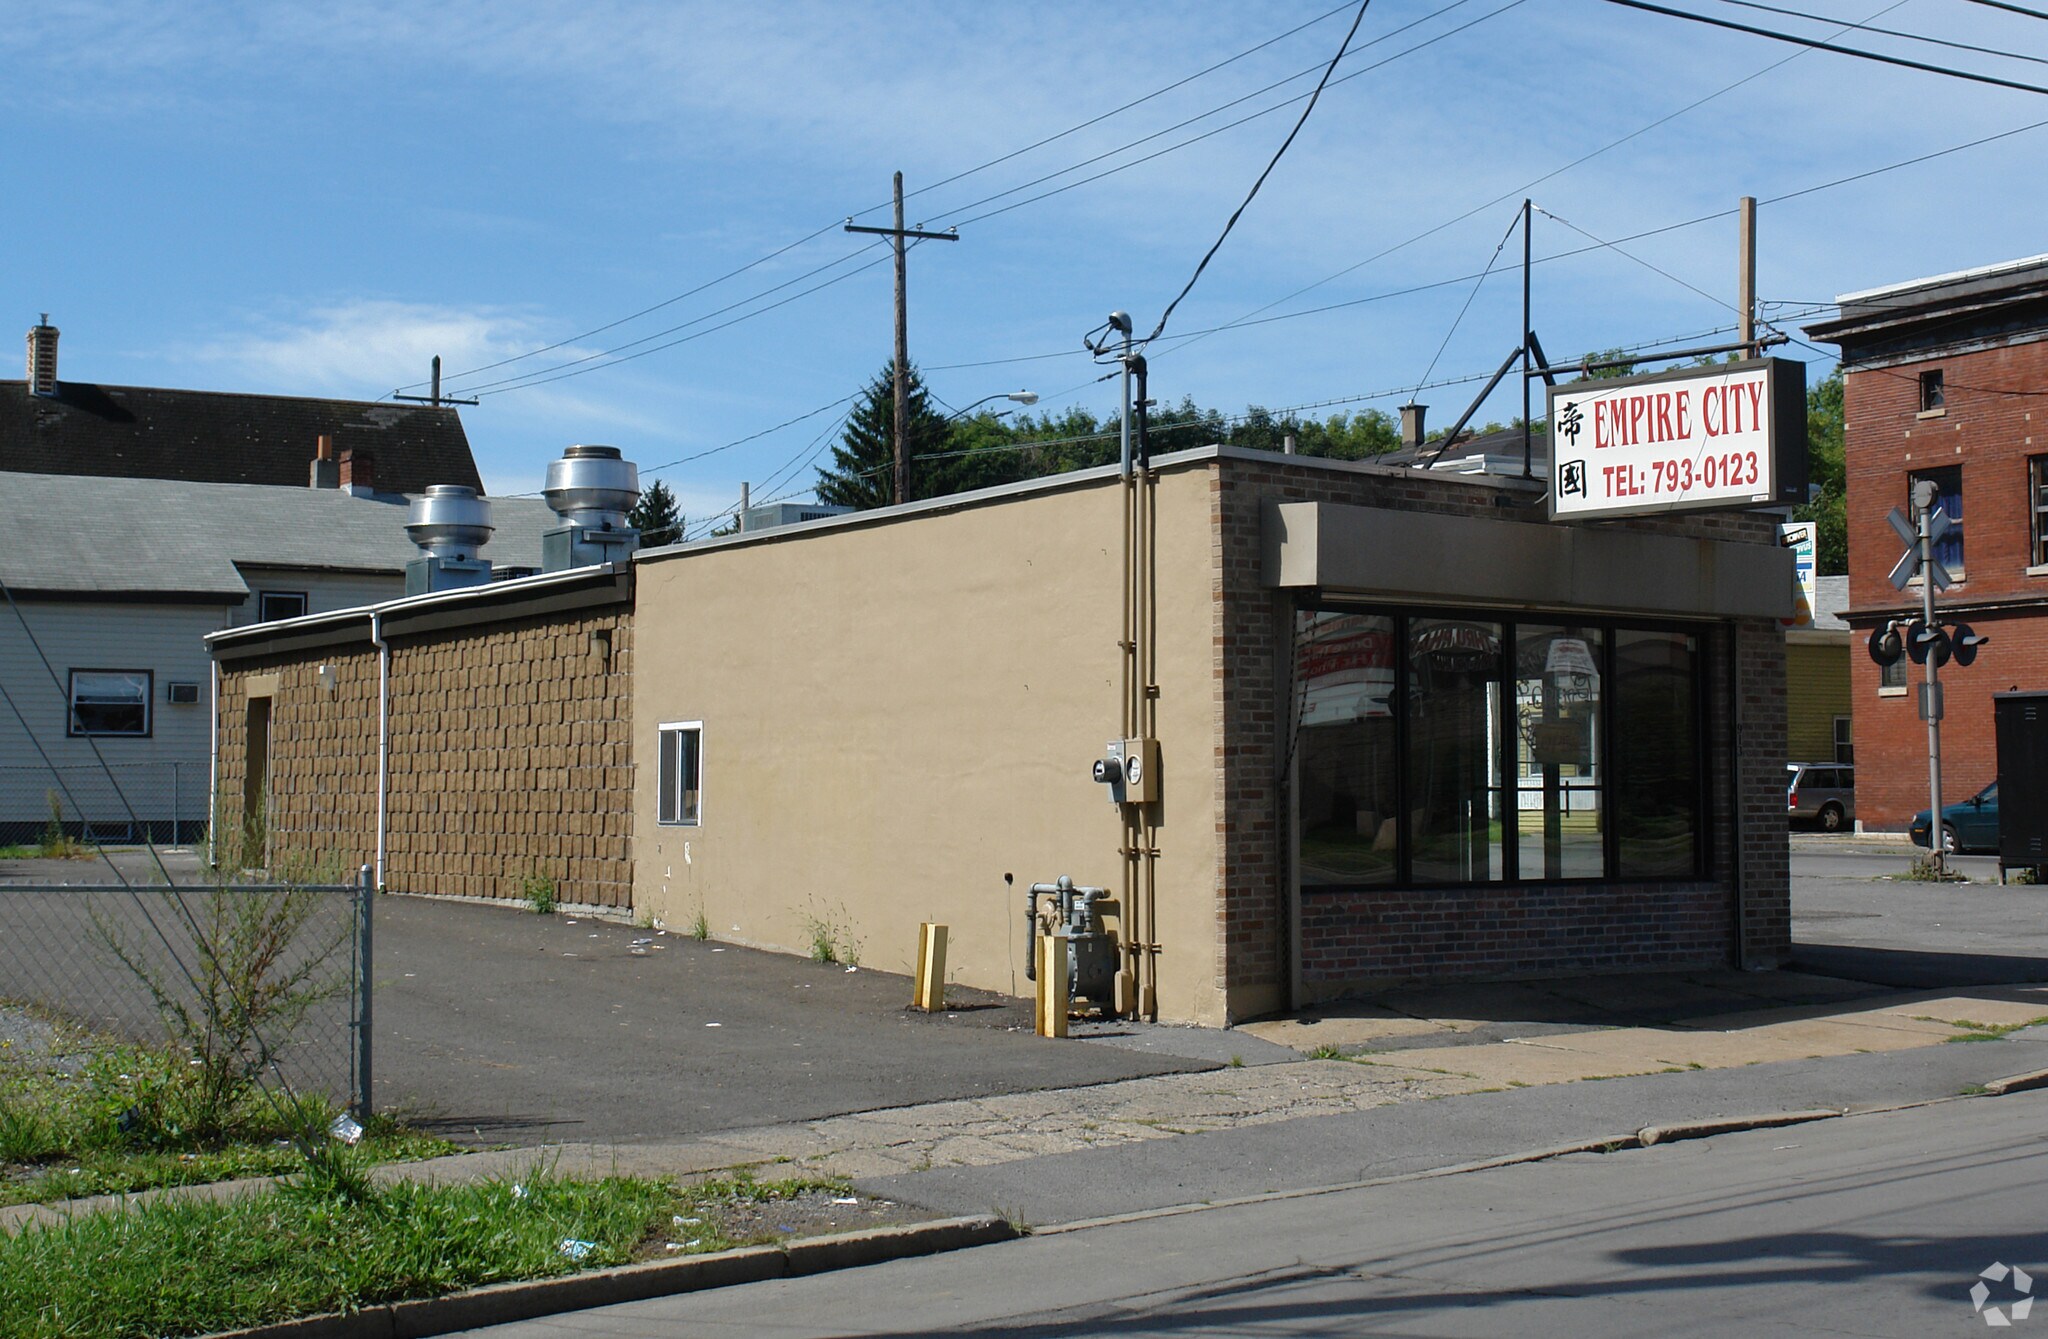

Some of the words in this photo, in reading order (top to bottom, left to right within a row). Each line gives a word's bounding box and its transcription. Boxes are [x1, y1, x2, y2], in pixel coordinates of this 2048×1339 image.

[1594, 390, 1692, 449] EMPIRE
[1703, 381, 1764, 437] CITY
[1603, 464, 1645, 498] TEL:
[1652, 451, 1759, 493] 793-0123
